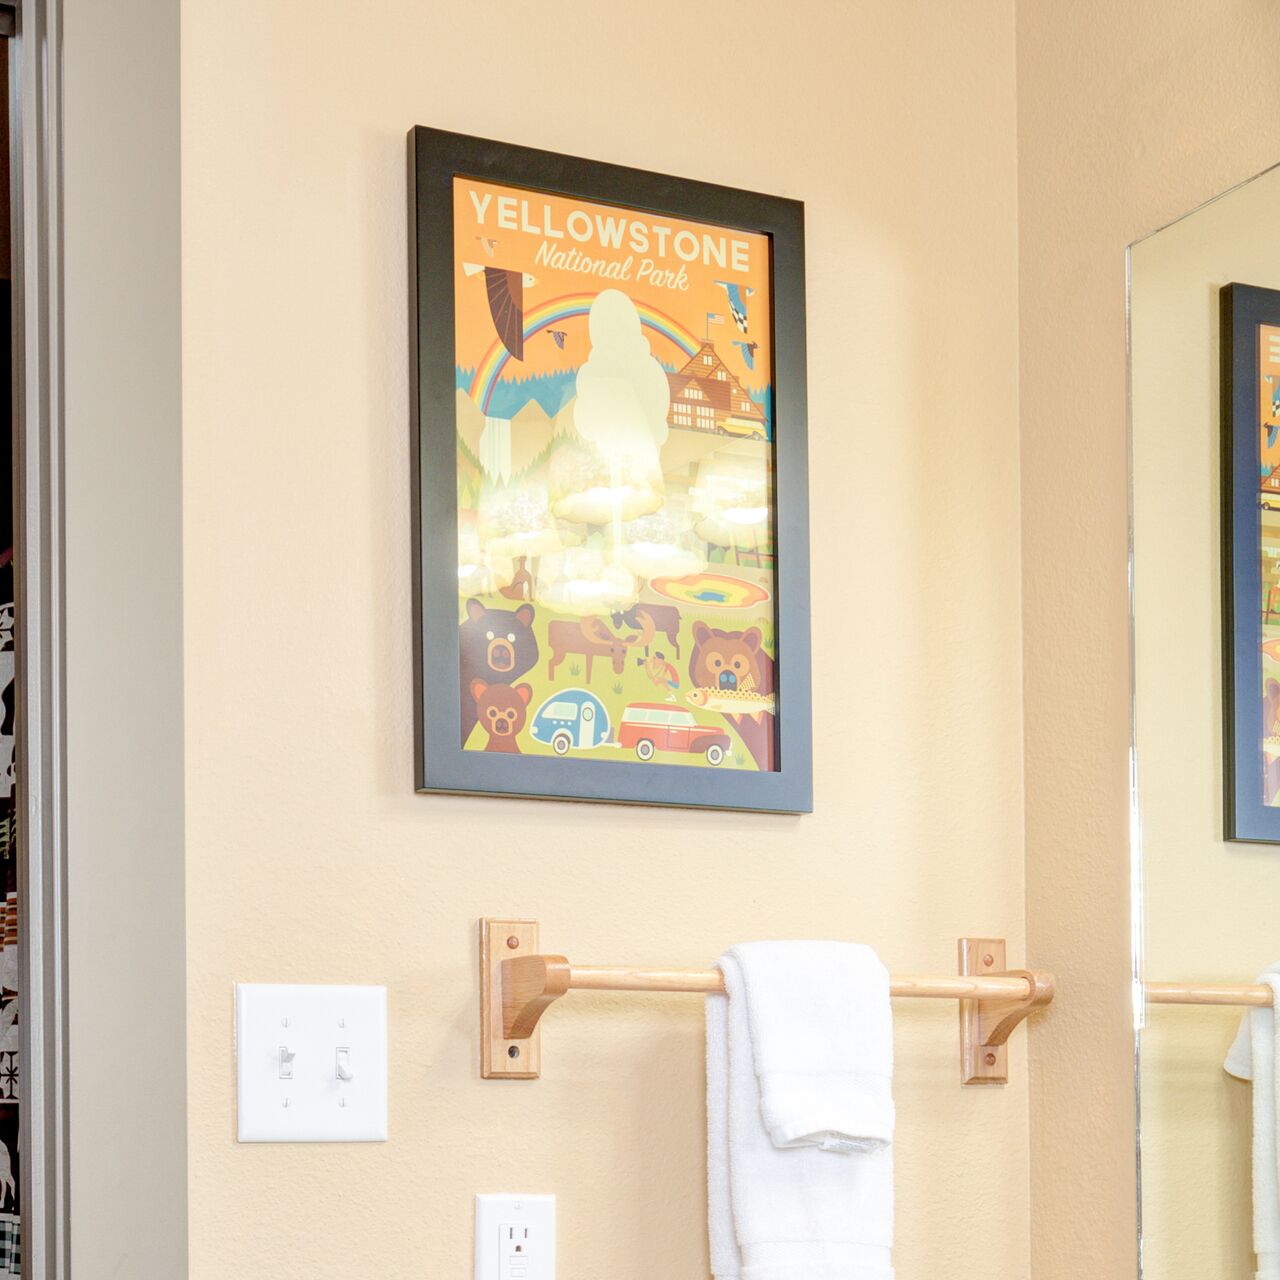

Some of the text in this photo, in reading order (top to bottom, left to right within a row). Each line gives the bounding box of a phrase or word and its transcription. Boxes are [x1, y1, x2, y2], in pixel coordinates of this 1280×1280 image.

[469, 191, 750, 272] YELLOWSTONE
[535, 241, 689, 291] National Park
